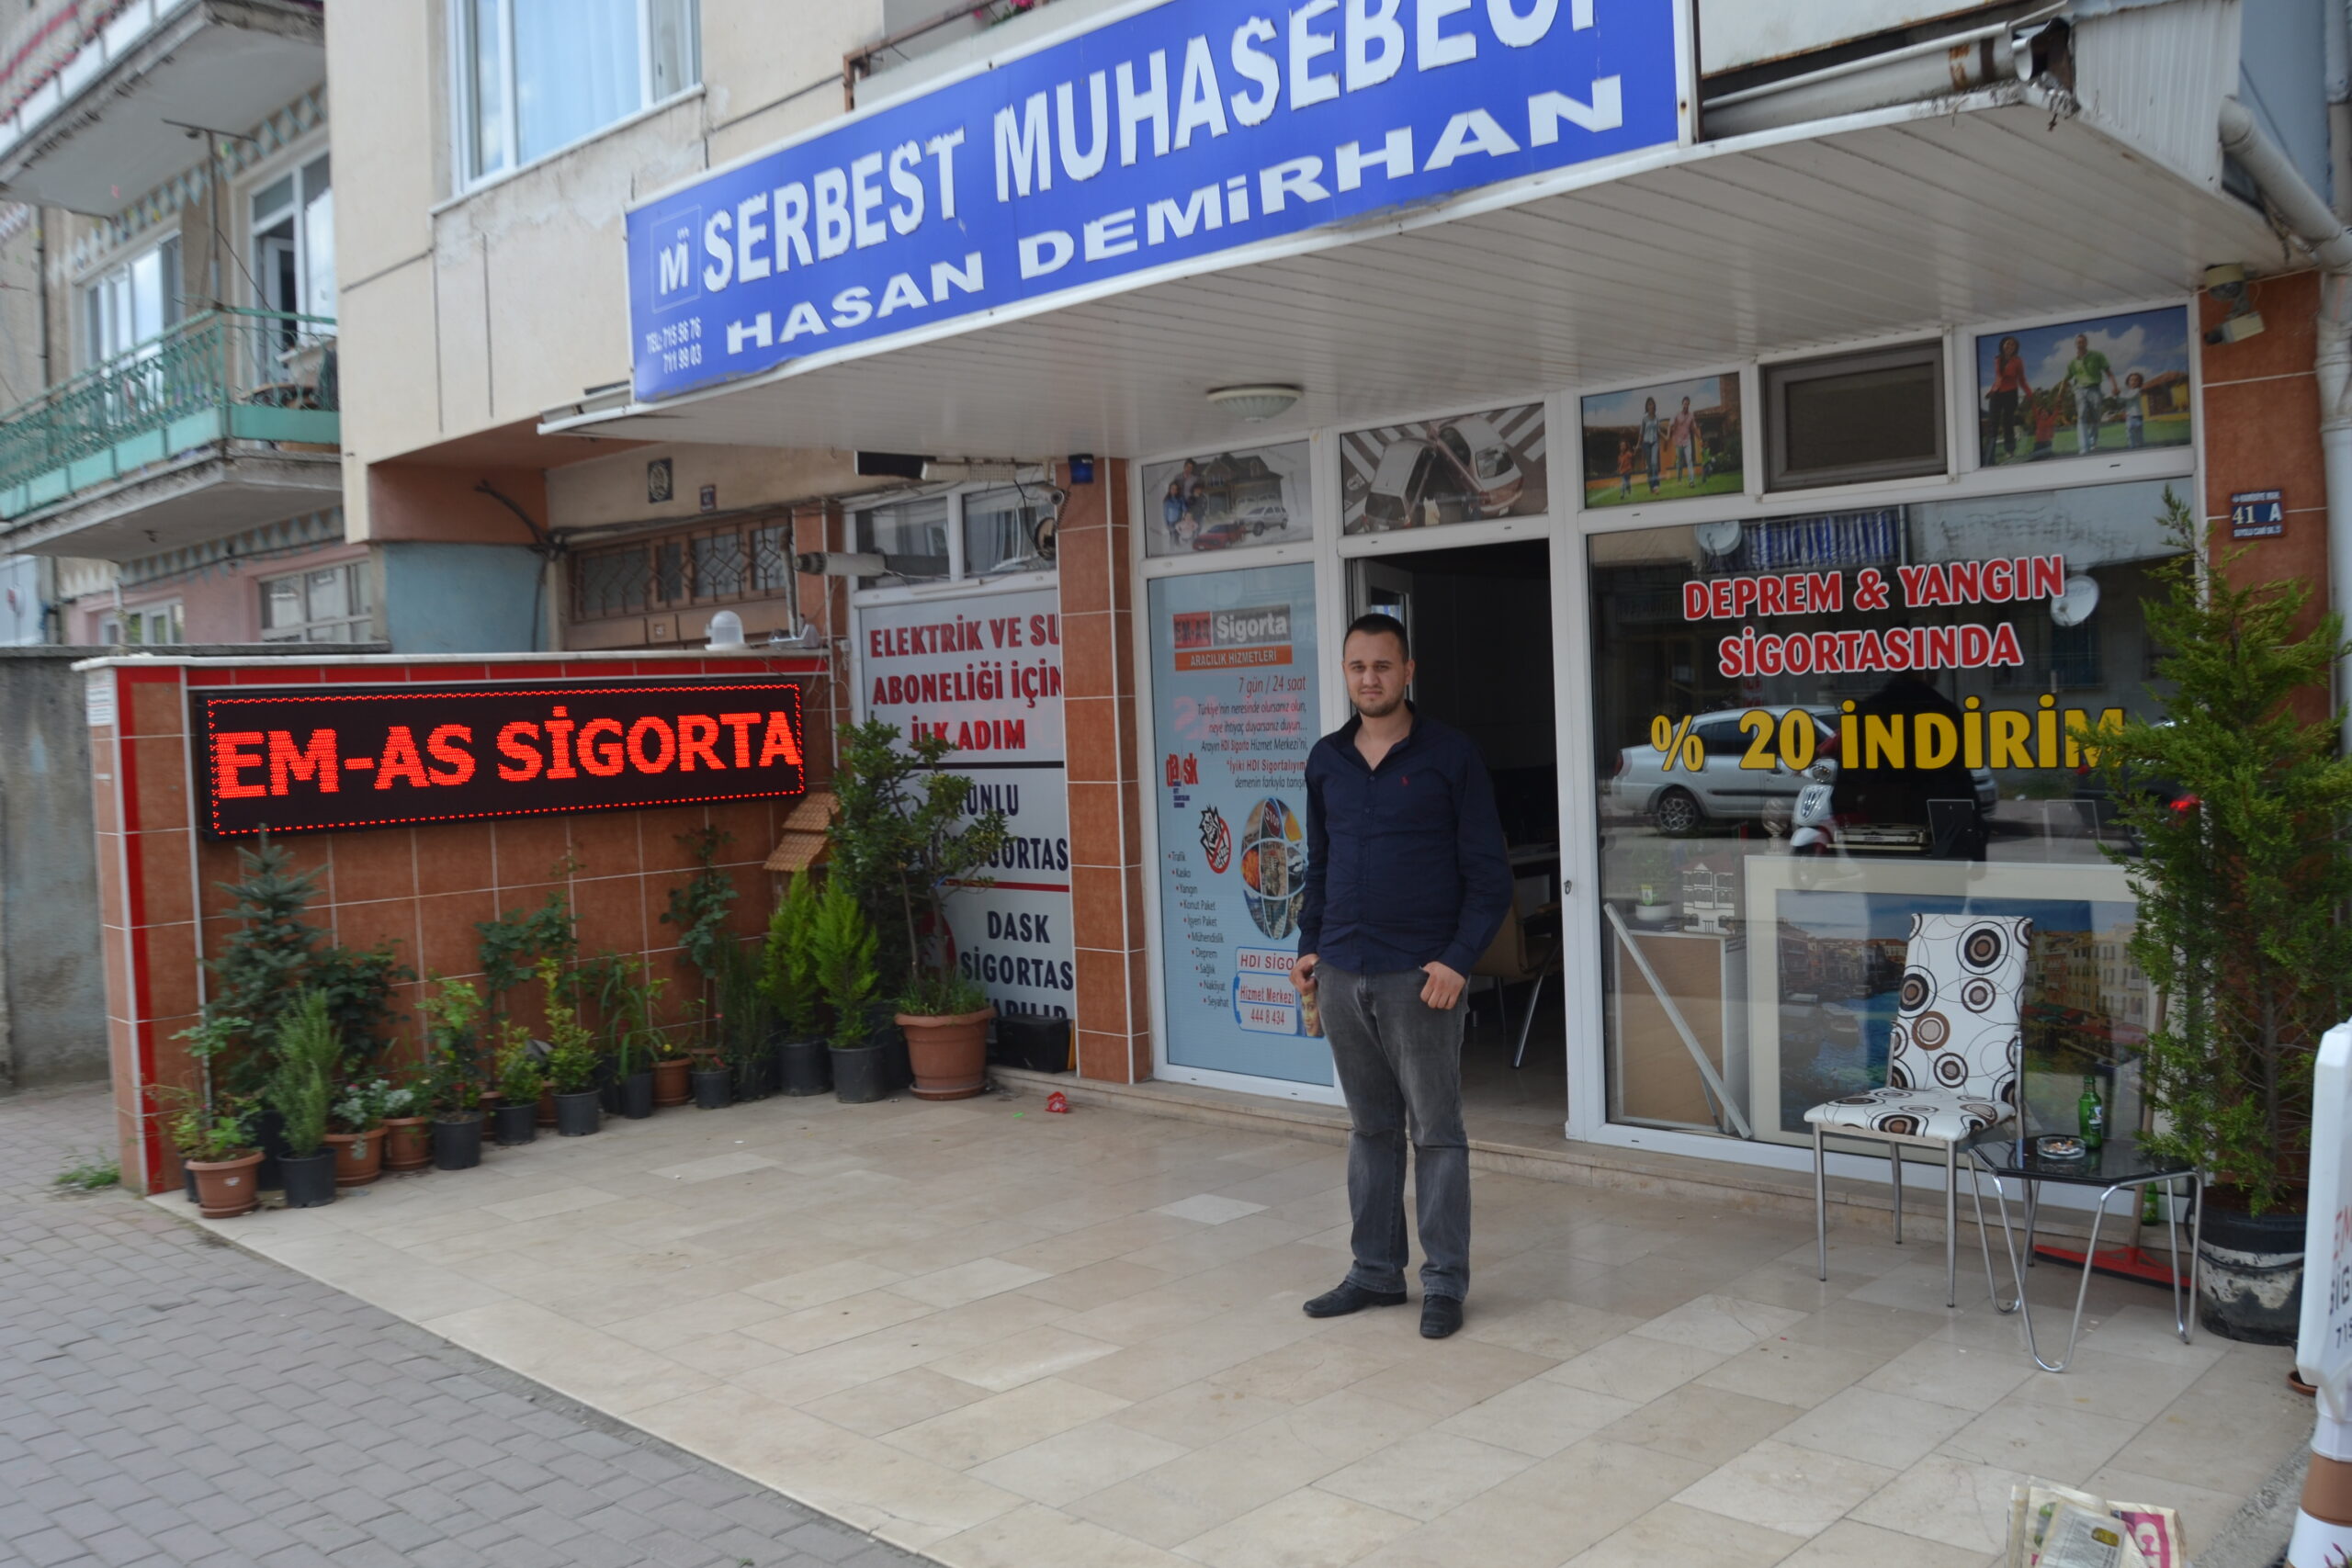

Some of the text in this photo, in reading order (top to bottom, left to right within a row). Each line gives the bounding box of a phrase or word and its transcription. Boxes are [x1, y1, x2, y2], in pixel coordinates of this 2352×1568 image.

[703, 126, 965, 292] SERBEST
[727, 75, 1623, 355] HASAN DEMİRHAN
[2233, 502, 2282, 525] 41 A
[1683, 570, 1842, 620] DEPREM
[1853, 567, 1890, 610] &
[1897, 554, 2064, 607] YANGIN
[870, 615, 983, 658] ELEKTRİK
[989, 617, 1022, 649] VE
[1216, 613, 1287, 642] Sigorta
[1191, 654, 1227, 667] ARACILIK
[1719, 622, 2023, 677] SİGORTASINDA
[873, 661, 1003, 705] ABONELİĞİ
[1238, 677, 1245, 693] 7
[1247, 676, 1263, 698] gün
[1272, 675, 1284, 692] 24
[1287, 677, 1306, 691] saat
[958, 719, 1025, 750] ADIM
[1250, 739, 1272, 750] Hizmet
[1651, 694, 2126, 773] % 20 İNDİRİM
[216, 706, 801, 799] EM-AS SİGORTA
[1247, 759, 1260, 771] HDI
[988, 910, 1050, 943] DASK
[1240, 954, 1261, 968] HDI
[1240, 985, 1295, 1004] Hizmet Merkezi
[1250, 1008, 1264, 1021] 444
